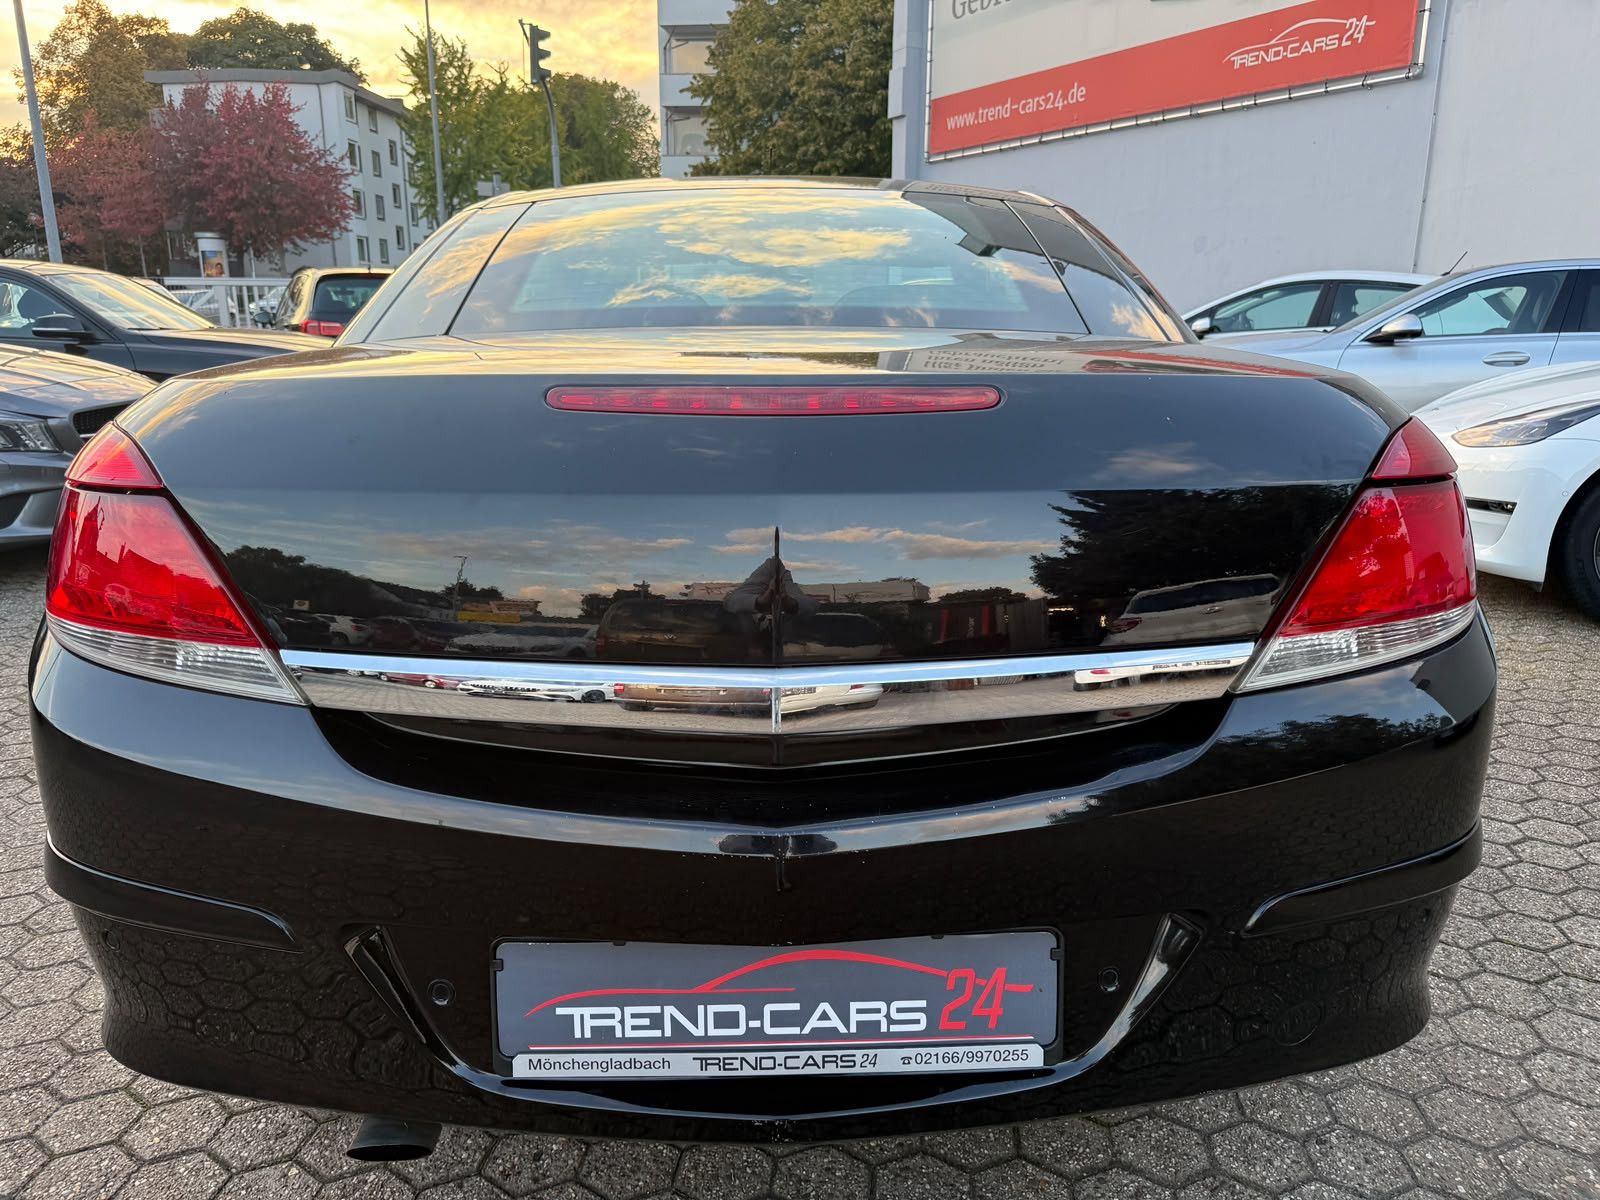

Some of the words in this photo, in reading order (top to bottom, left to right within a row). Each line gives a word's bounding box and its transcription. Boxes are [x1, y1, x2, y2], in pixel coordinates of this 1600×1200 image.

[946, 82, 1086, 130] www.trend-cars24.de
[555, 1000, 927, 1038] TREND-CARS
[938, 967, 1007, 1031] 24
[528, 1057, 671, 1073] Mönchengladbach
[692, 1054, 856, 1072] TREND-CARS
[859, 1053, 878, 1068] 24
[914, 1049, 1029, 1065] 02166/9970255
